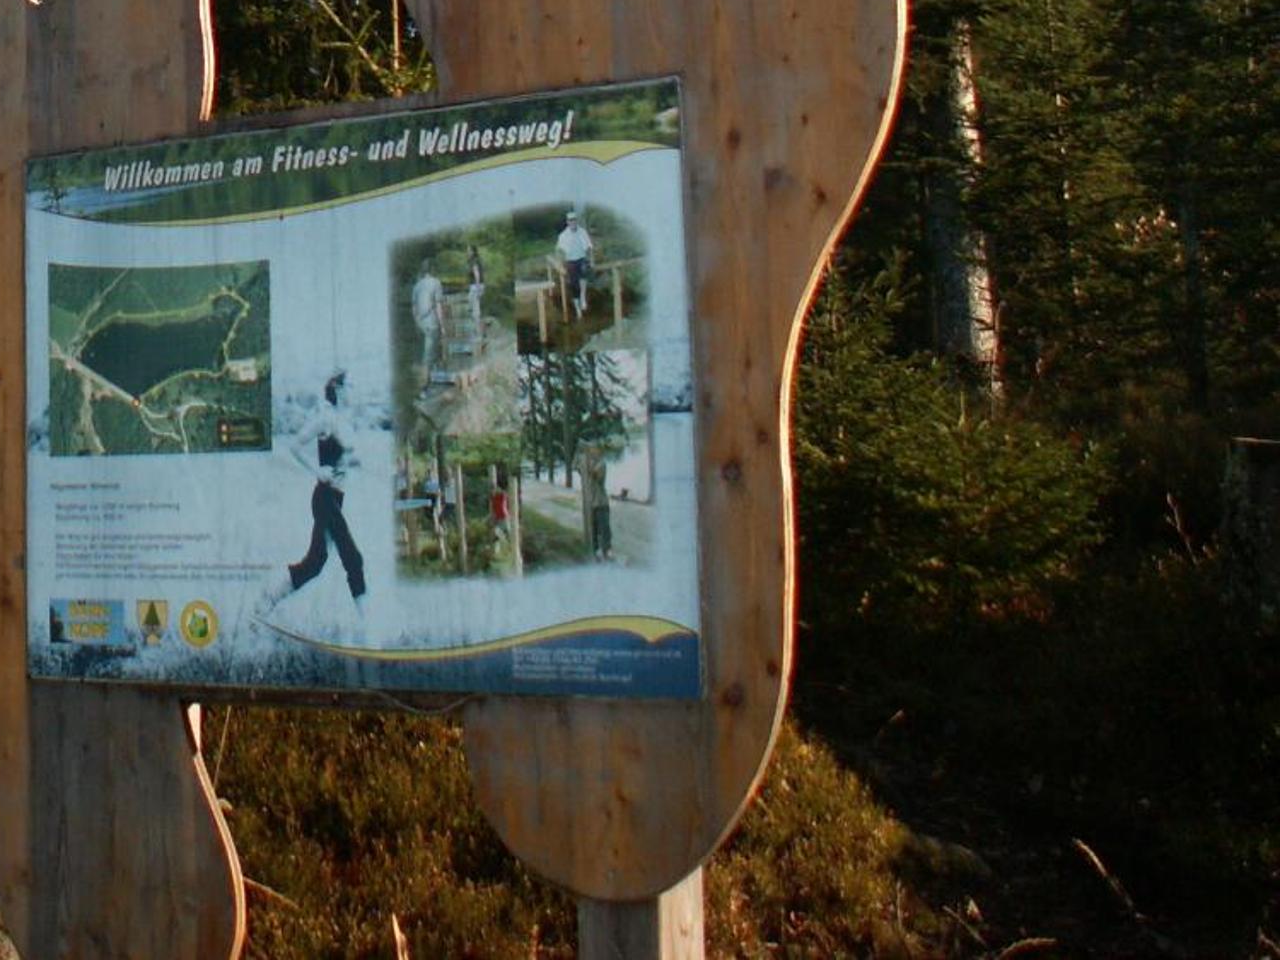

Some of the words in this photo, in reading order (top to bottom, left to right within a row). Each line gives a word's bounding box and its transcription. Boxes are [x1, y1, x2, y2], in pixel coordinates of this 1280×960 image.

[104, 159, 224, 191] Willkommen
[232, 155, 263, 177] am
[272, 143, 358, 173] Fitness-
[368, 128, 410, 161] und
[419, 109, 574, 157] Wellnessweg!
